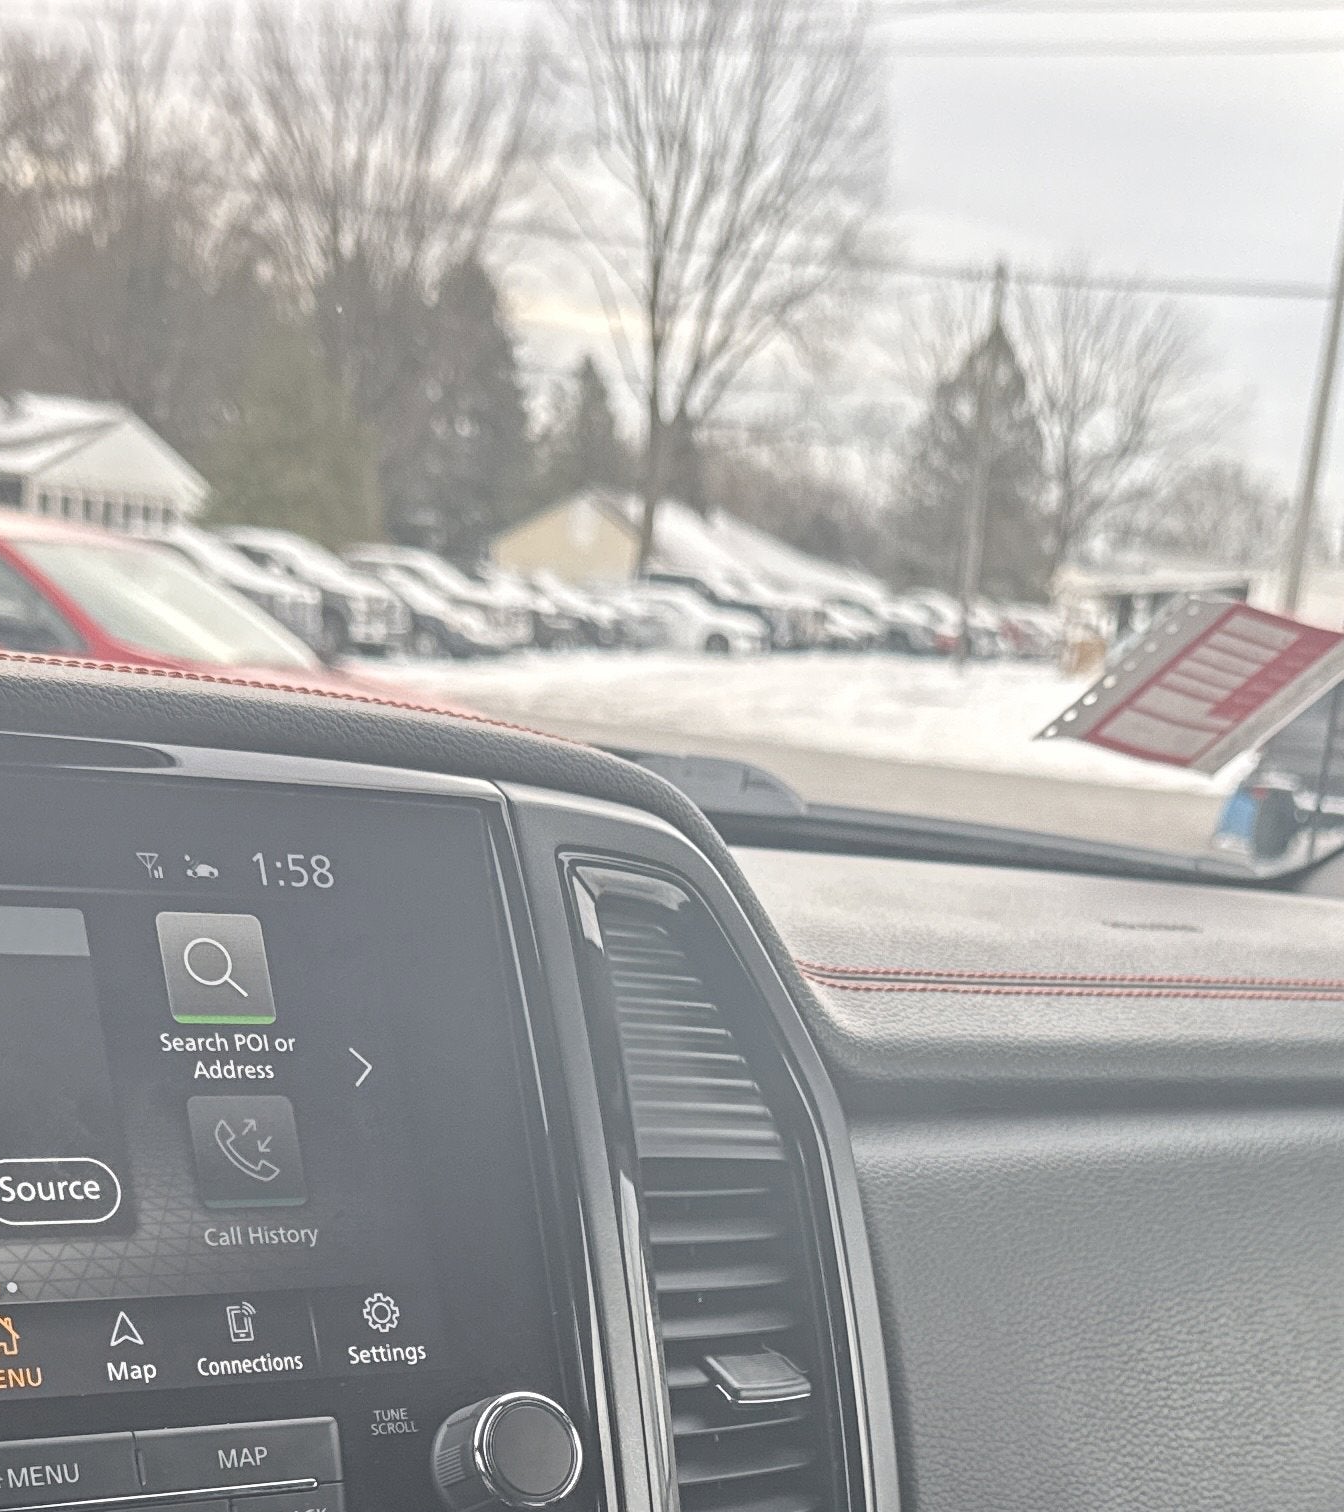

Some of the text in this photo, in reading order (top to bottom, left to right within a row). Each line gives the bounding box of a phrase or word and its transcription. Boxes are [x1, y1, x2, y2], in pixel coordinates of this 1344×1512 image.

[251, 851, 336, 889] 1:58
[159, 1032, 296, 1054] Search POI or
[193, 1060, 275, 1081] Address
[203, 1225, 319, 1249] Call History
[197, 1353, 304, 1377] Connections
[347, 1342, 427, 1366] Settings
[106, 1360, 158, 1383] Map
[372, 1410, 409, 1423] TUNE
[370, 1422, 419, 1436] SCROLL
[217, 1445, 269, 1470] MAP
[6, 1463, 81, 1490] MENU
